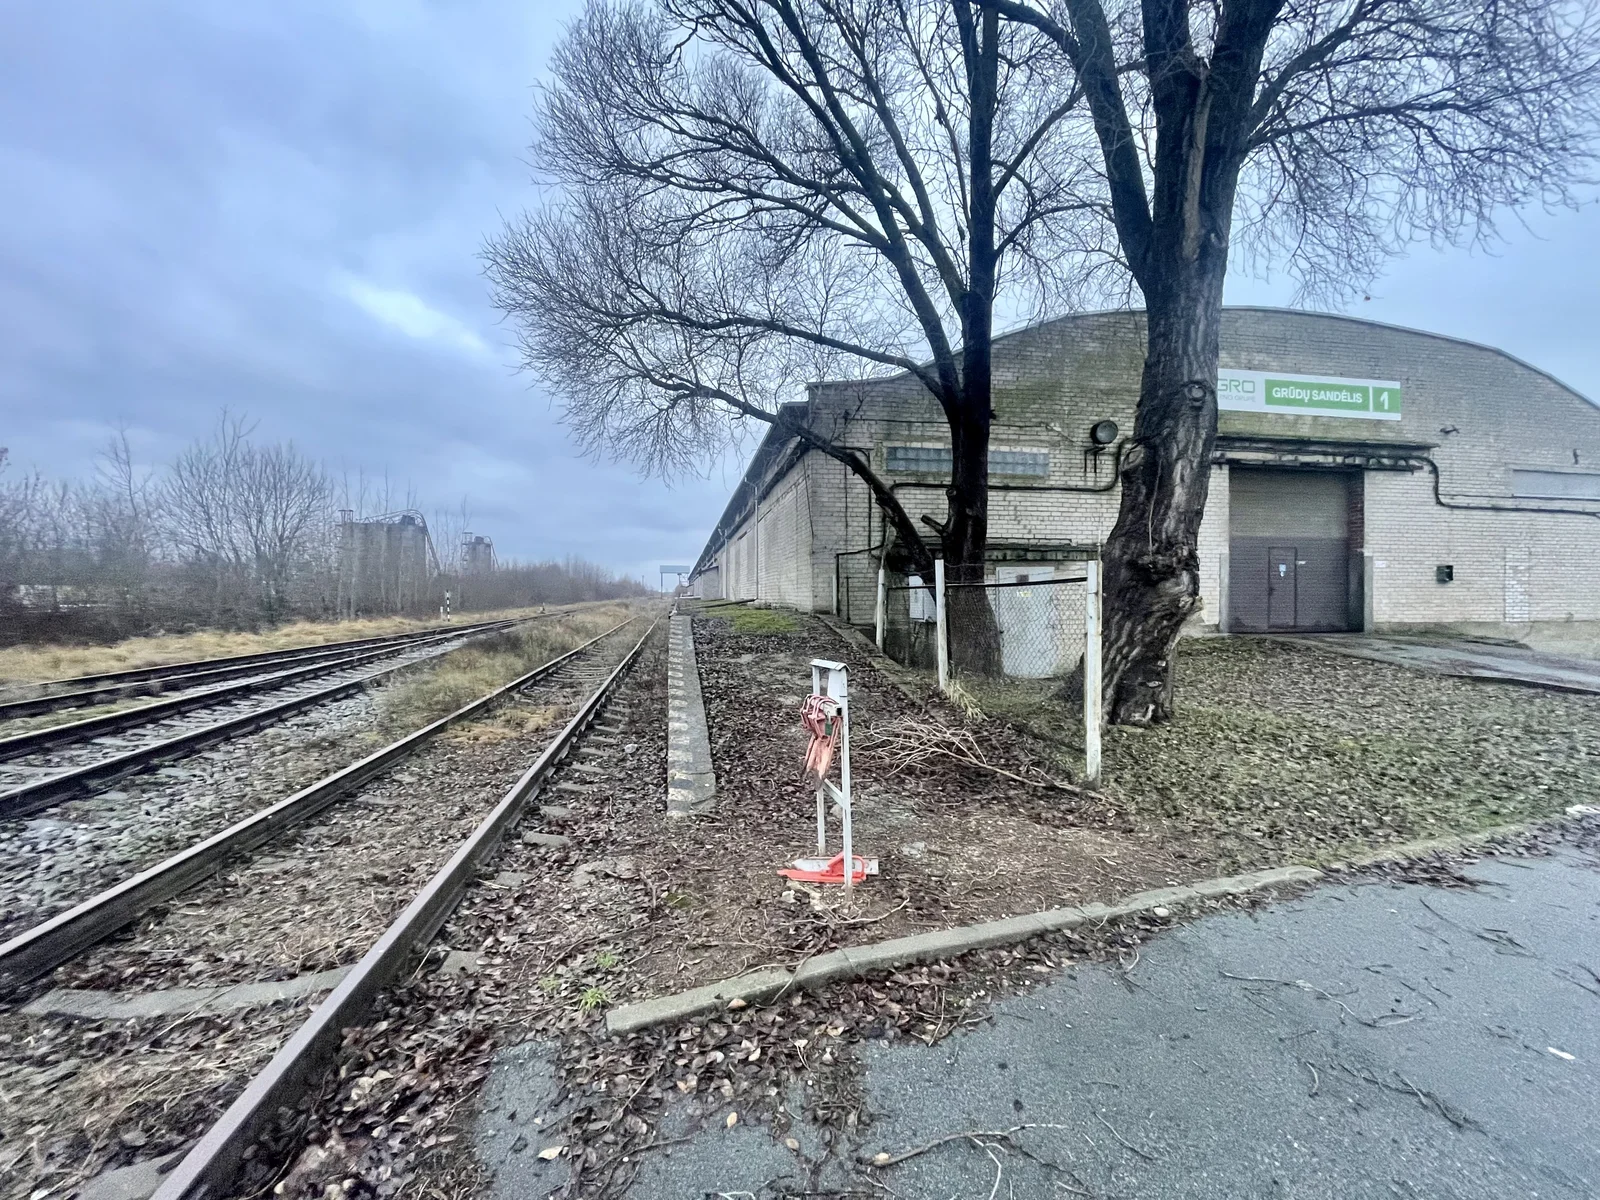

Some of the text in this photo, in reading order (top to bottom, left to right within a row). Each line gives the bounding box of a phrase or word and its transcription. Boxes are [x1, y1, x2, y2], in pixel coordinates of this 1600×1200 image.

[1217, 379, 1255, 393] GRO
[1272, 387, 1310, 402] GRŪDŲ
[1380, 391, 1389, 410] 1
